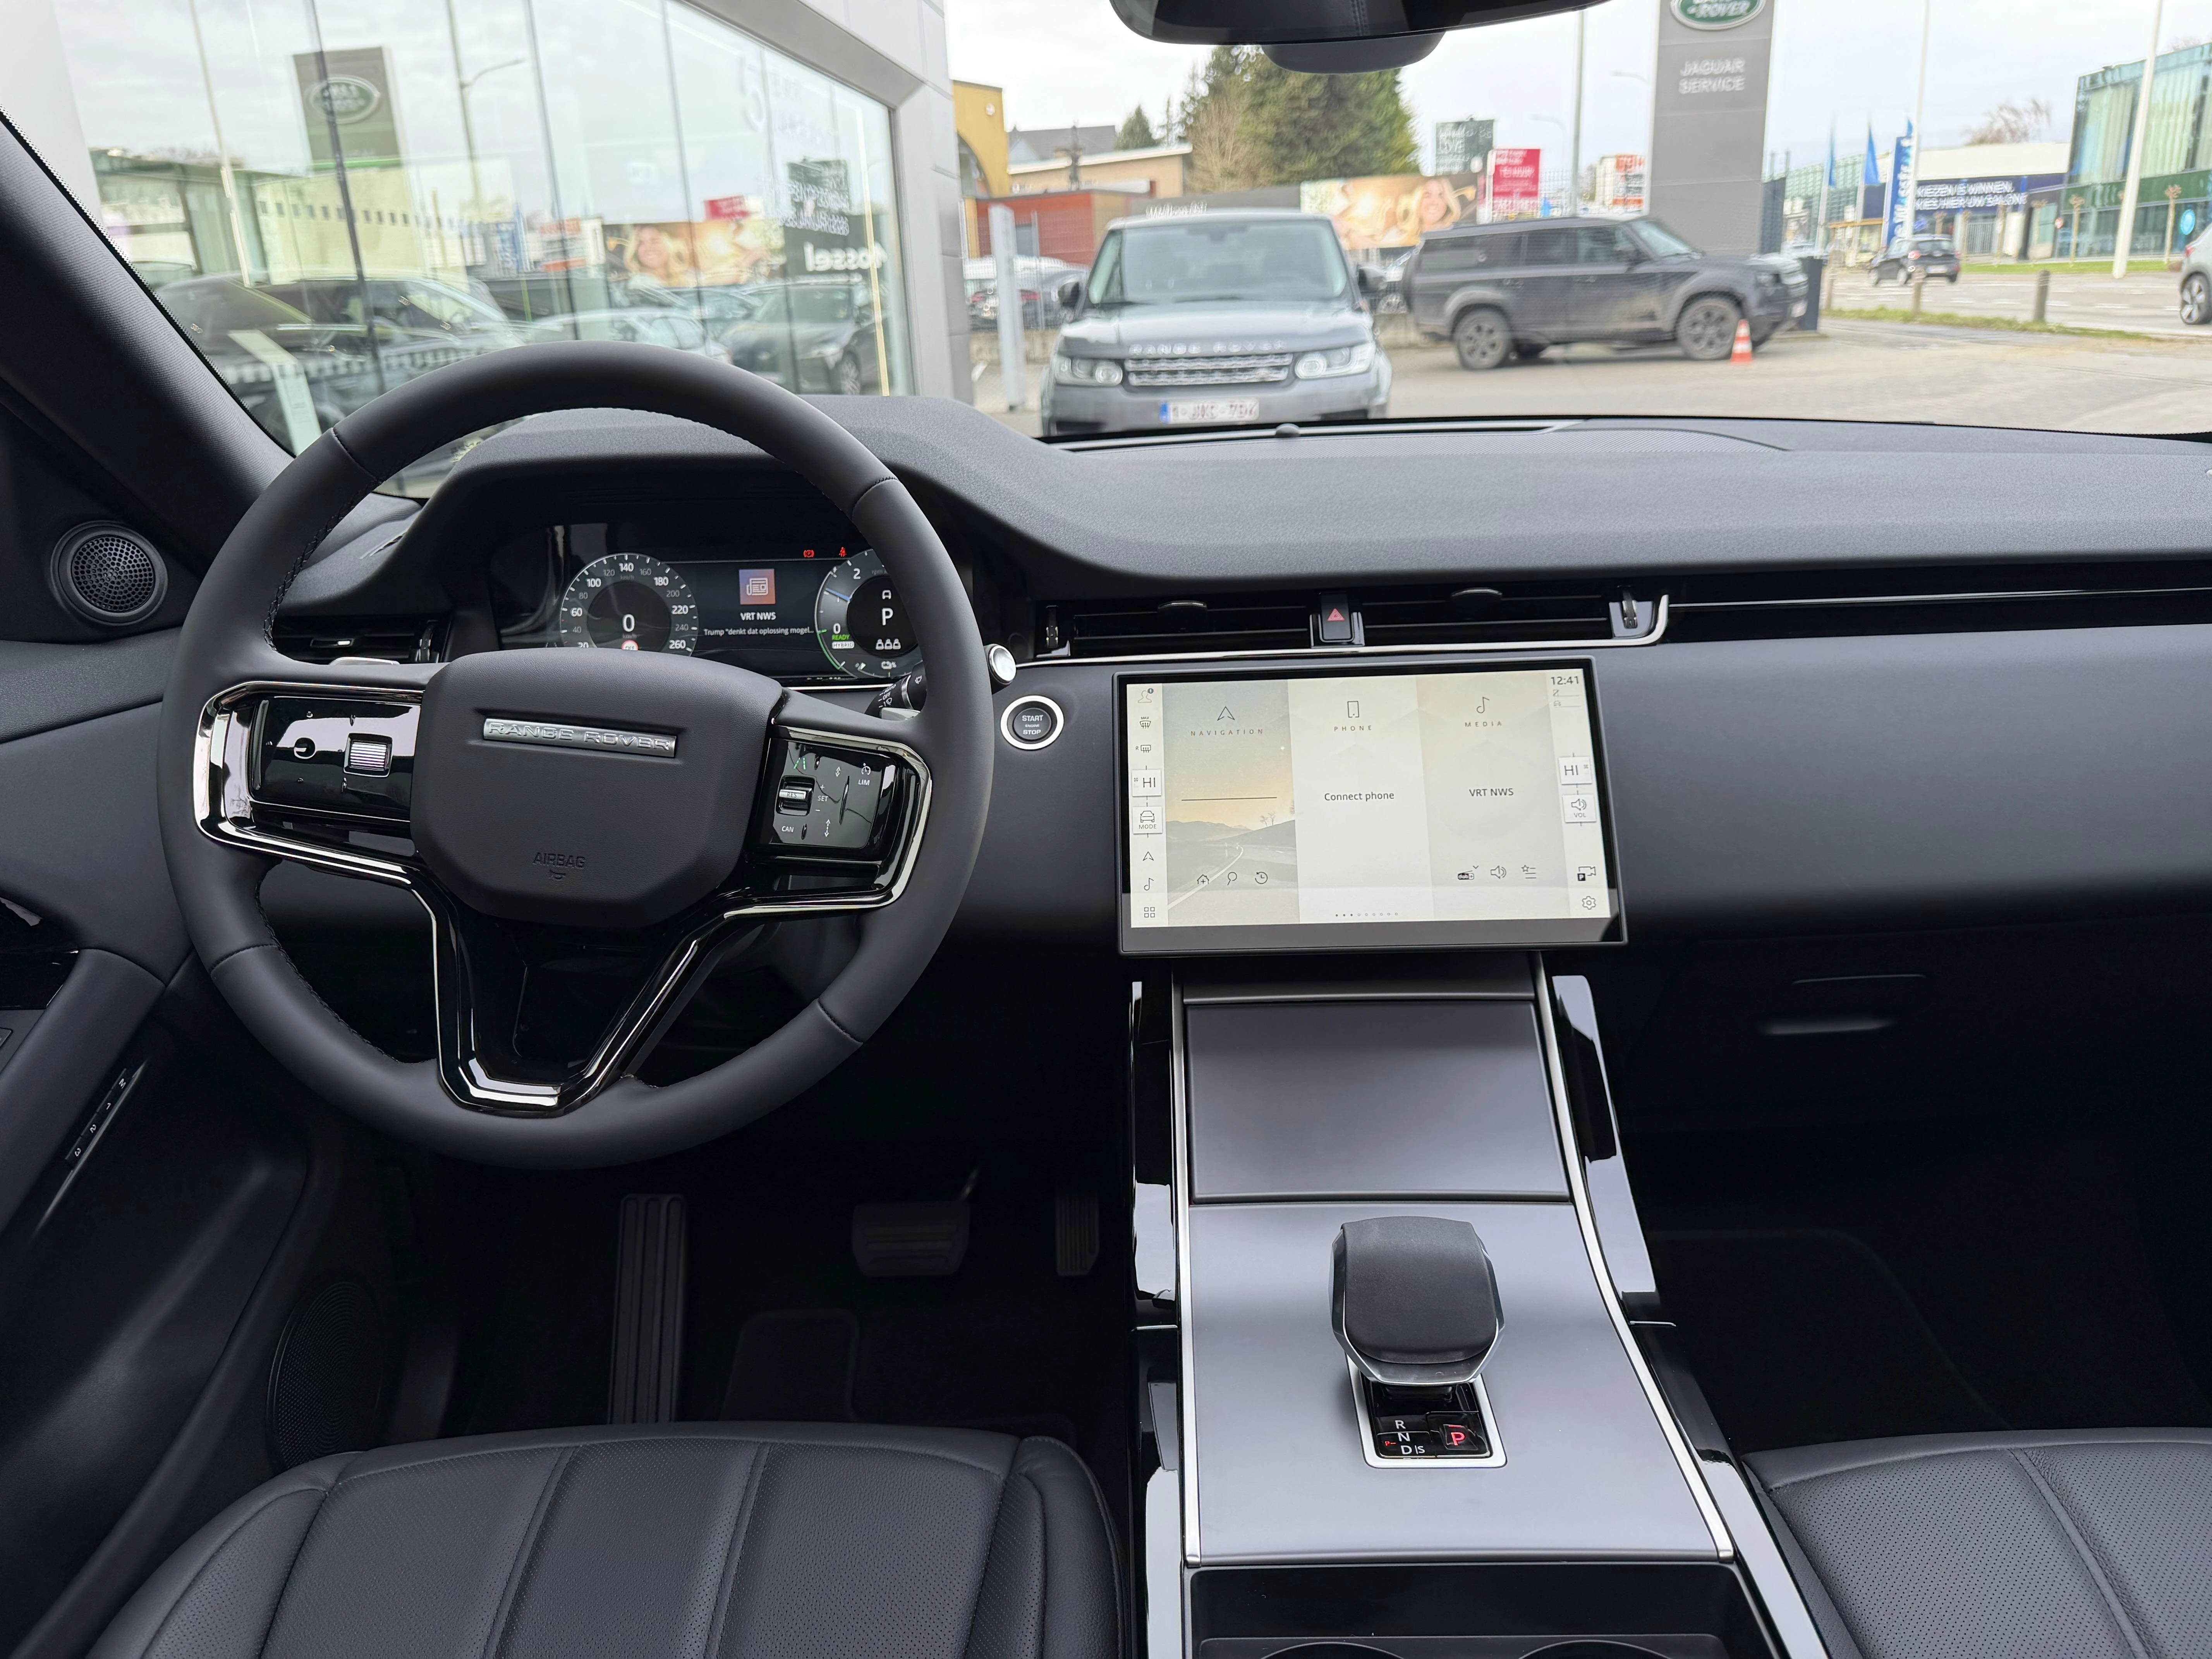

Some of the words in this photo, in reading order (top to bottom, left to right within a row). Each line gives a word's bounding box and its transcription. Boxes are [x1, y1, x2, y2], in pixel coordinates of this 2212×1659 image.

[1695, 2, 1751, 18] ROVER
[1680, 58, 1746, 76] JAGUAR
[1678, 76, 1745, 94] SERVICE
[1129, 344, 1201, 355] RANGE
[1212, 340, 1287, 353] ROVER
[619, 563, 634, 572] 140
[853, 568, 861, 579] 2
[587, 578, 601, 587] 100
[654, 576, 669, 586] 180
[666, 590, 680, 598] 200
[571, 608, 582, 617] 60
[672, 605, 689, 615] 220
[740, 612, 756, 620] VRT
[756, 611, 776, 620] NWS
[882, 608, 893, 626] P
[622, 614, 635, 632] 0
[759, 627, 789, 635] oplossing
[833, 623, 841, 634] 0
[669, 639, 686, 649] 260
[1551, 676, 1579, 685] 12:41
[883, 684, 896, 694] AUTO
[883, 692, 891, 701] OFF
[489, 722, 575, 741] RANGE
[584, 731, 670, 750] ROVER
[1564, 765, 1579, 776] HI
[1143, 777, 1156, 788] HI
[1324, 793, 1363, 801] Connect
[1365, 792, 1395, 802] phone
[1490, 788, 1514, 796] NWS
[533, 852, 585, 869] AIRBAG
[118, 1078, 126, 1089] M
[89, 1124, 97, 1133] 2
[74, 1148, 82, 1157] 3
[1395, 1420, 1406, 1430] R
[1398, 1433, 1410, 1442] N
[1450, 1432, 1465, 1446] P
